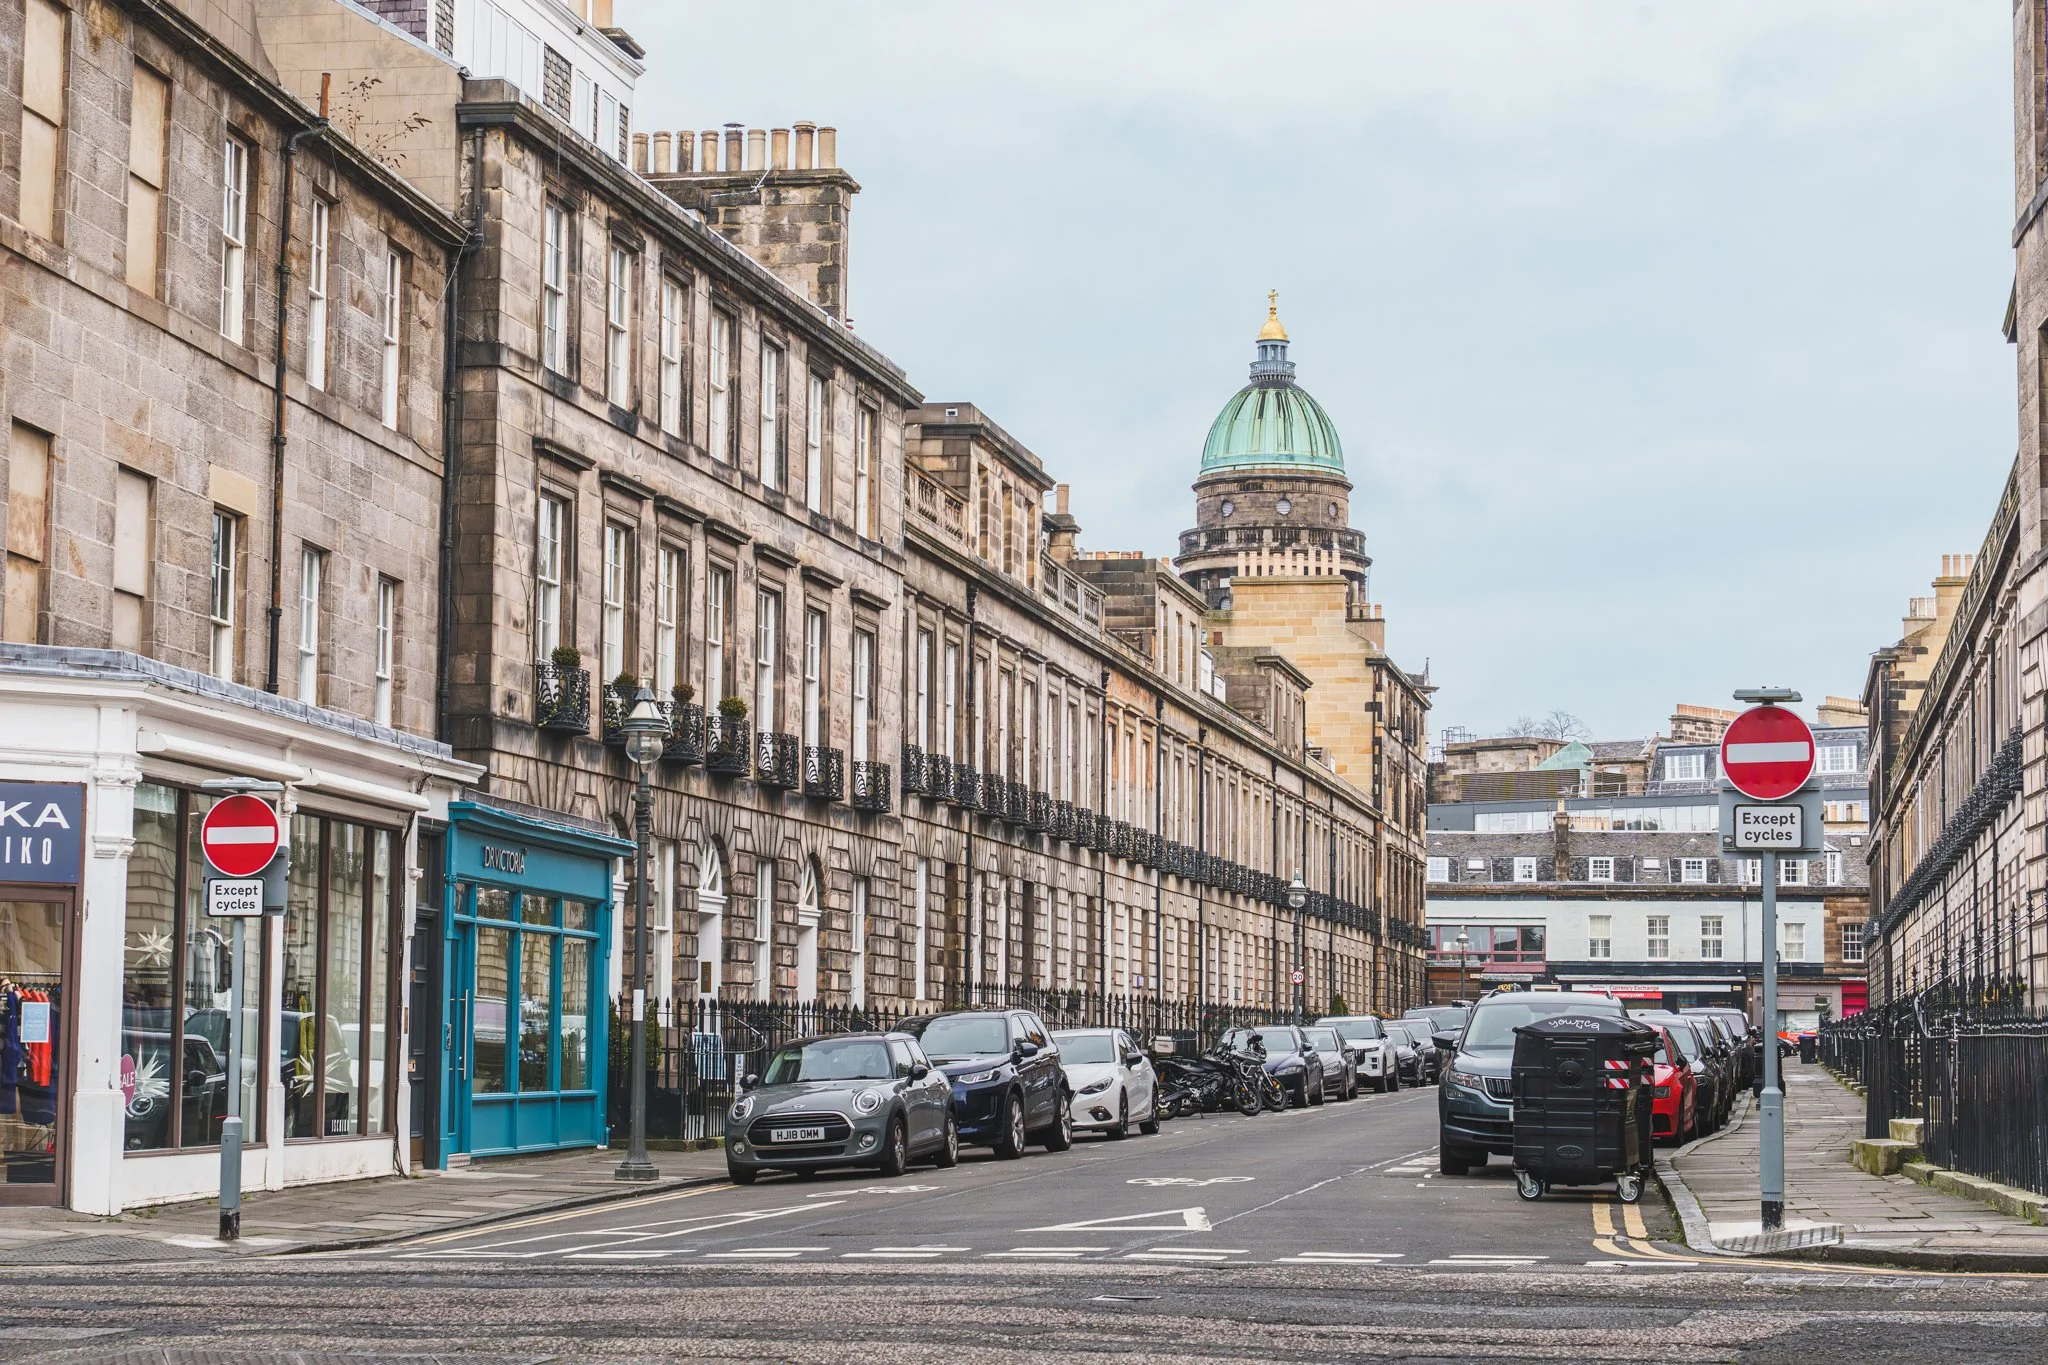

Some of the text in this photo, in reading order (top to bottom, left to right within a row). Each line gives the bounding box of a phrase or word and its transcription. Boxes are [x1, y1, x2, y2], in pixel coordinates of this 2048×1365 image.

[0, 800, 71, 829] KA
[1742, 812, 1796, 827] Except
[1744, 828, 1793, 843] cycles
[5, 836, 52, 865] IKO
[215, 884, 259, 898] Except
[216, 898, 256, 912] cycles
[1294, 973, 1303, 981] 20
[776, 1130, 798, 1141] HJ18
